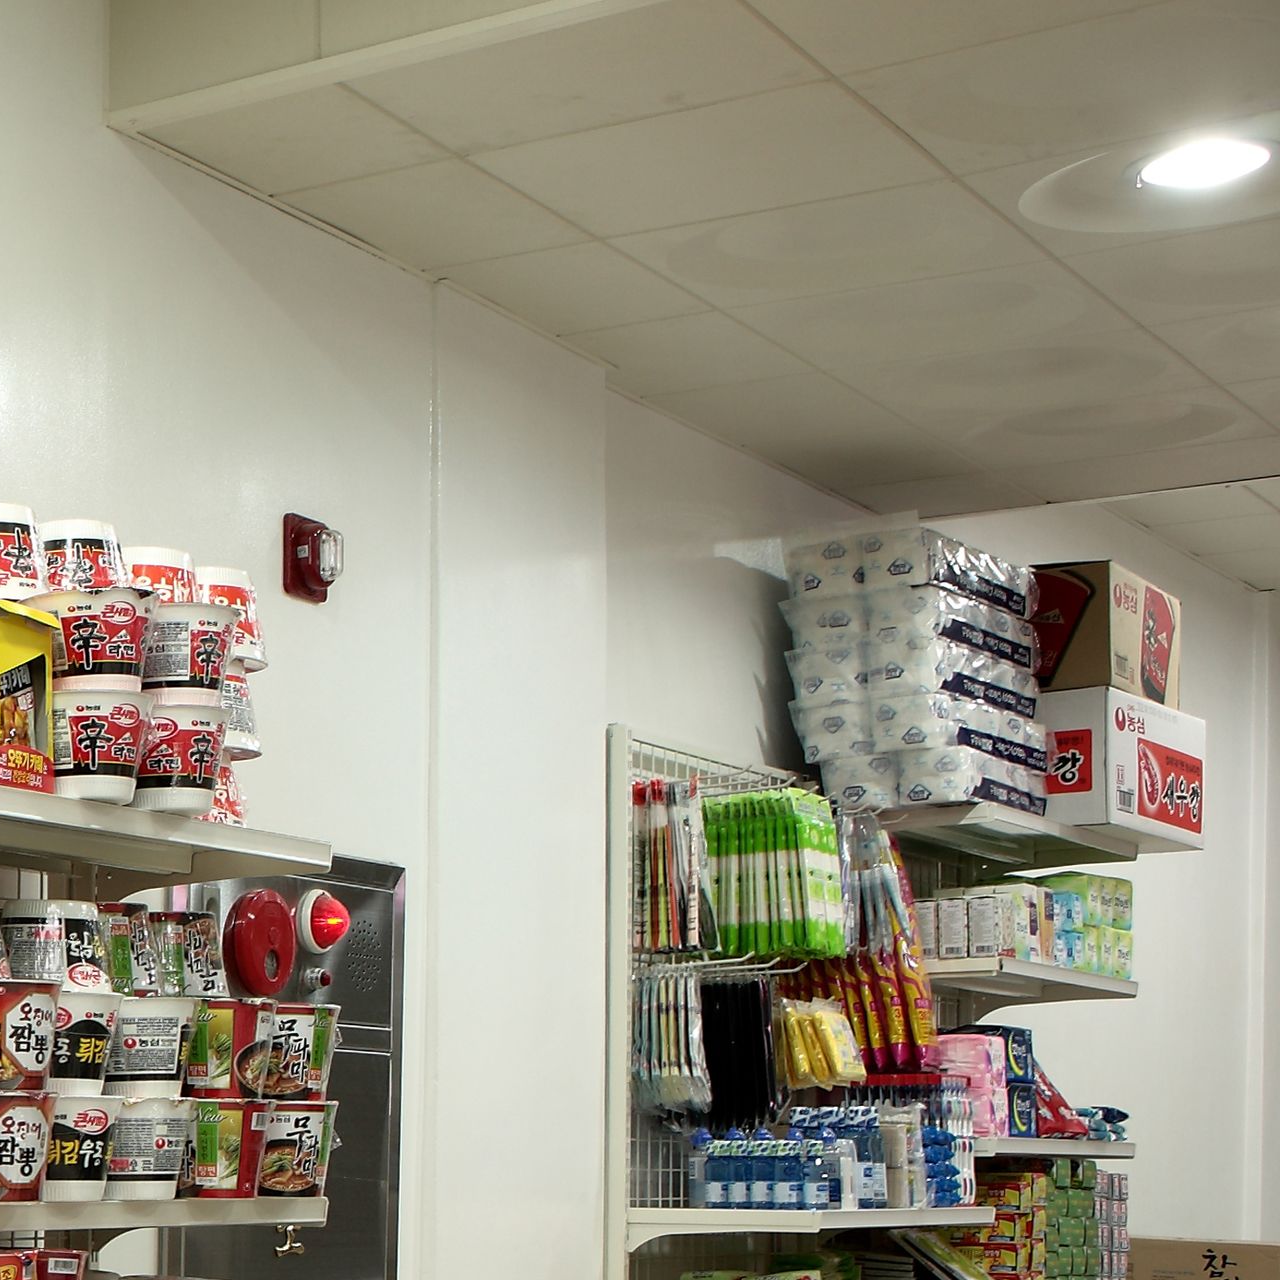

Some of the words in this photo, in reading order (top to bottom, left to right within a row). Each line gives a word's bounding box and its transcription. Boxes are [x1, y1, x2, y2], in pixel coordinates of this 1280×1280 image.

[68, 616, 108, 671] 辛
[107, 640, 138, 660] 라면
[195, 631, 223, 687] 辛
[1127, 709, 1146, 735] 농심
[75, 717, 117, 772] 辛
[112, 740, 140, 762] 라면
[188, 731, 216, 784] 辛
[1161, 772, 1202, 823] 새우깡
[8, 1022, 50, 1064] 짬뽕
[74, 1036, 108, 1064] 튀김
[0, 1114, 42, 1138] 오징어
[194, 1107, 226, 1124] New
